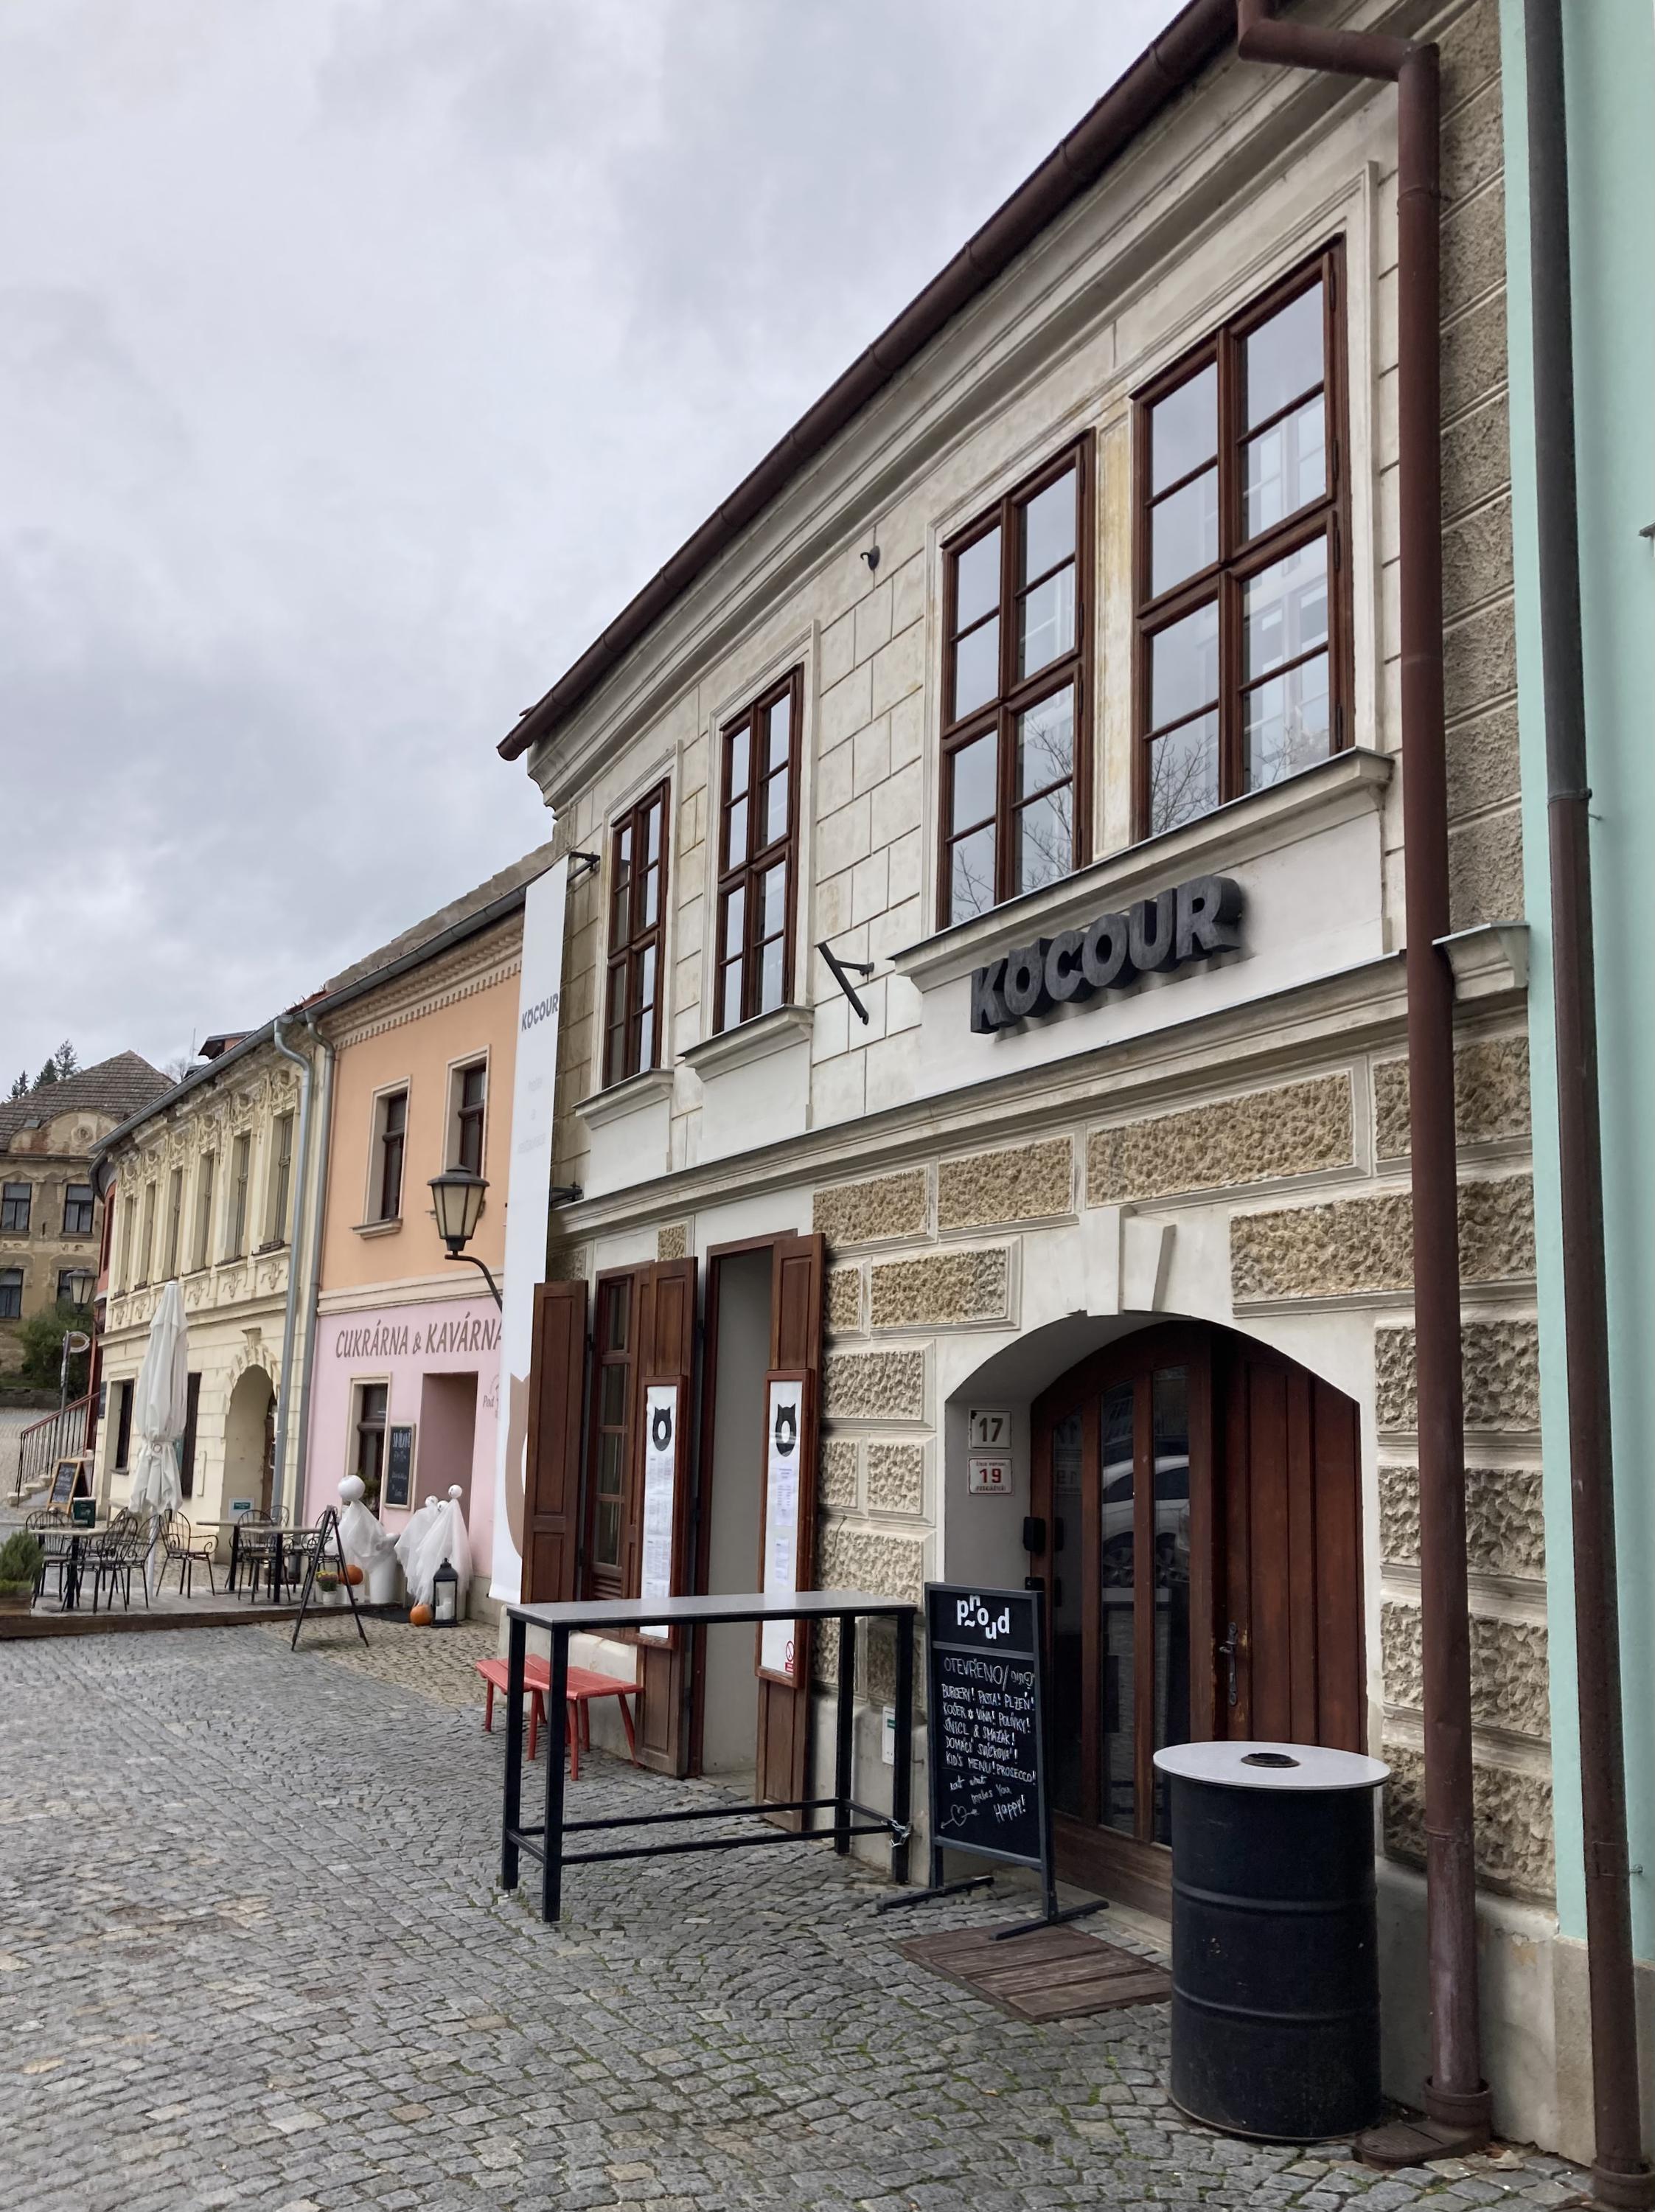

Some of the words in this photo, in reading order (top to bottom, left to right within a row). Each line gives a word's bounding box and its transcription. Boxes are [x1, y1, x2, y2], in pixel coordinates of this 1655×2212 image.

[970, 874, 1243, 1034] KOCOUR
[521, 992, 559, 1032] KOCOUR
[336, 1319, 408, 1358] CUKRÁRNA
[412, 1331, 422, 1355] &
[979, 1417, 1003, 1442] 17
[979, 1468, 1002, 1484] 19
[957, 1594, 1010, 1640] proud
[973, 1724, 980, 1739] &
[996, 1763, 1036, 1785] PROSECCO!
